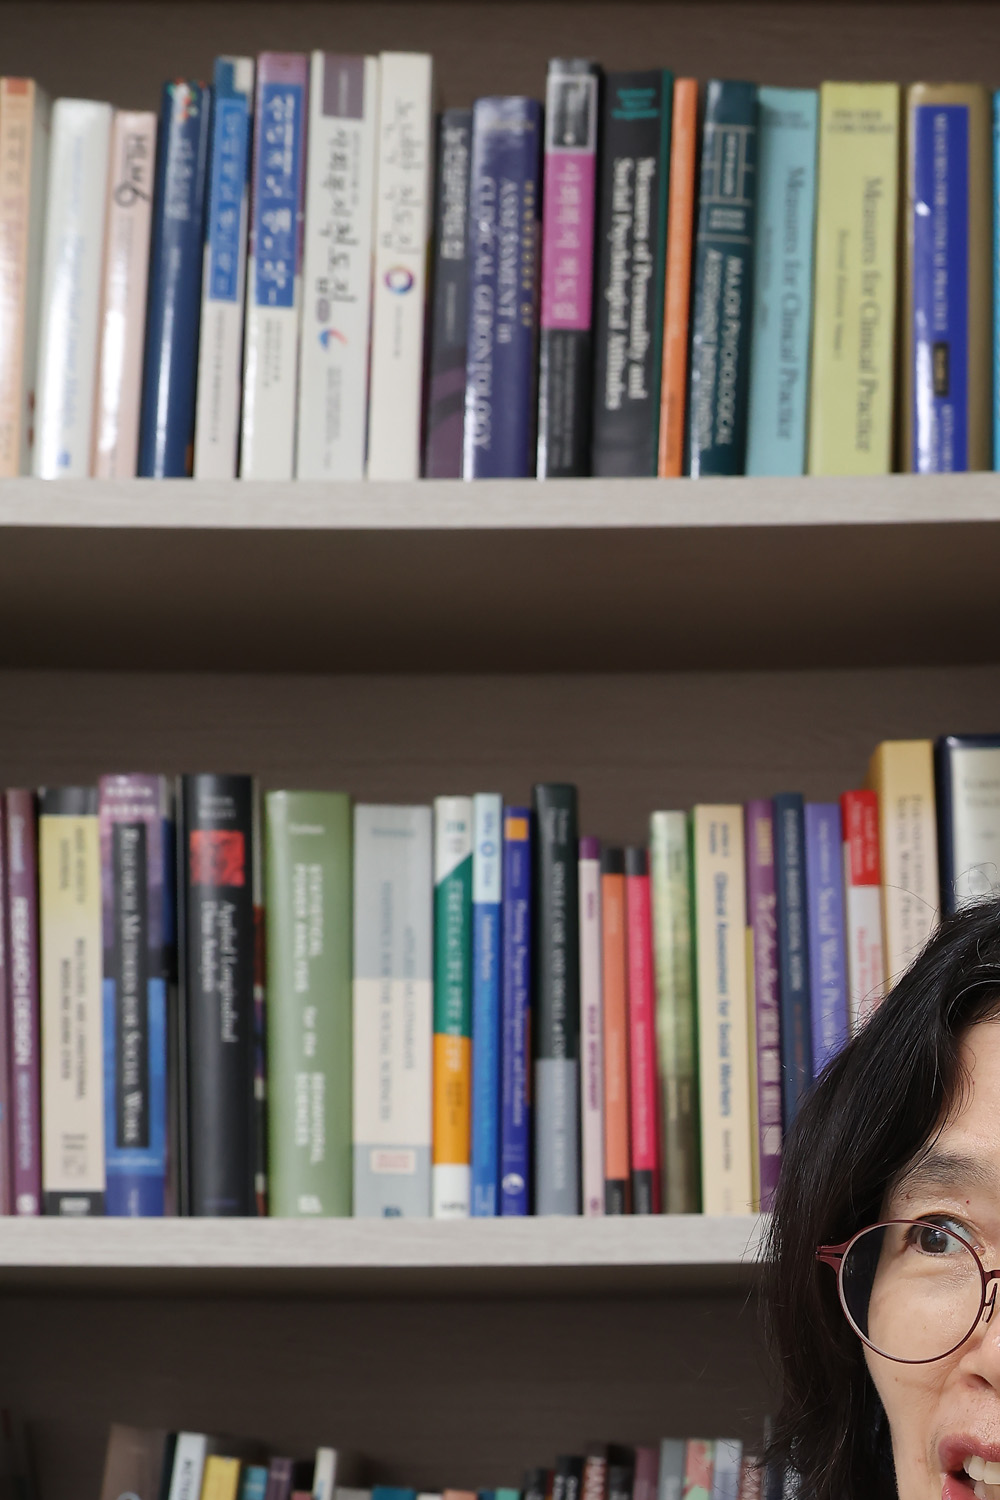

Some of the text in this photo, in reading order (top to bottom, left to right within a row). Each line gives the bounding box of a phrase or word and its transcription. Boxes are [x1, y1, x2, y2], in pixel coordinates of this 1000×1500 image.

[121, 827, 140, 911] RESEARCH
[817, 887, 836, 929] Social
[12, 897, 32, 1063] RESEARCH DESIGN
[819, 939, 838, 983] Work
[122, 1030, 142, 1088] SOCIAL
[122, 1091, 143, 1141] WORK
